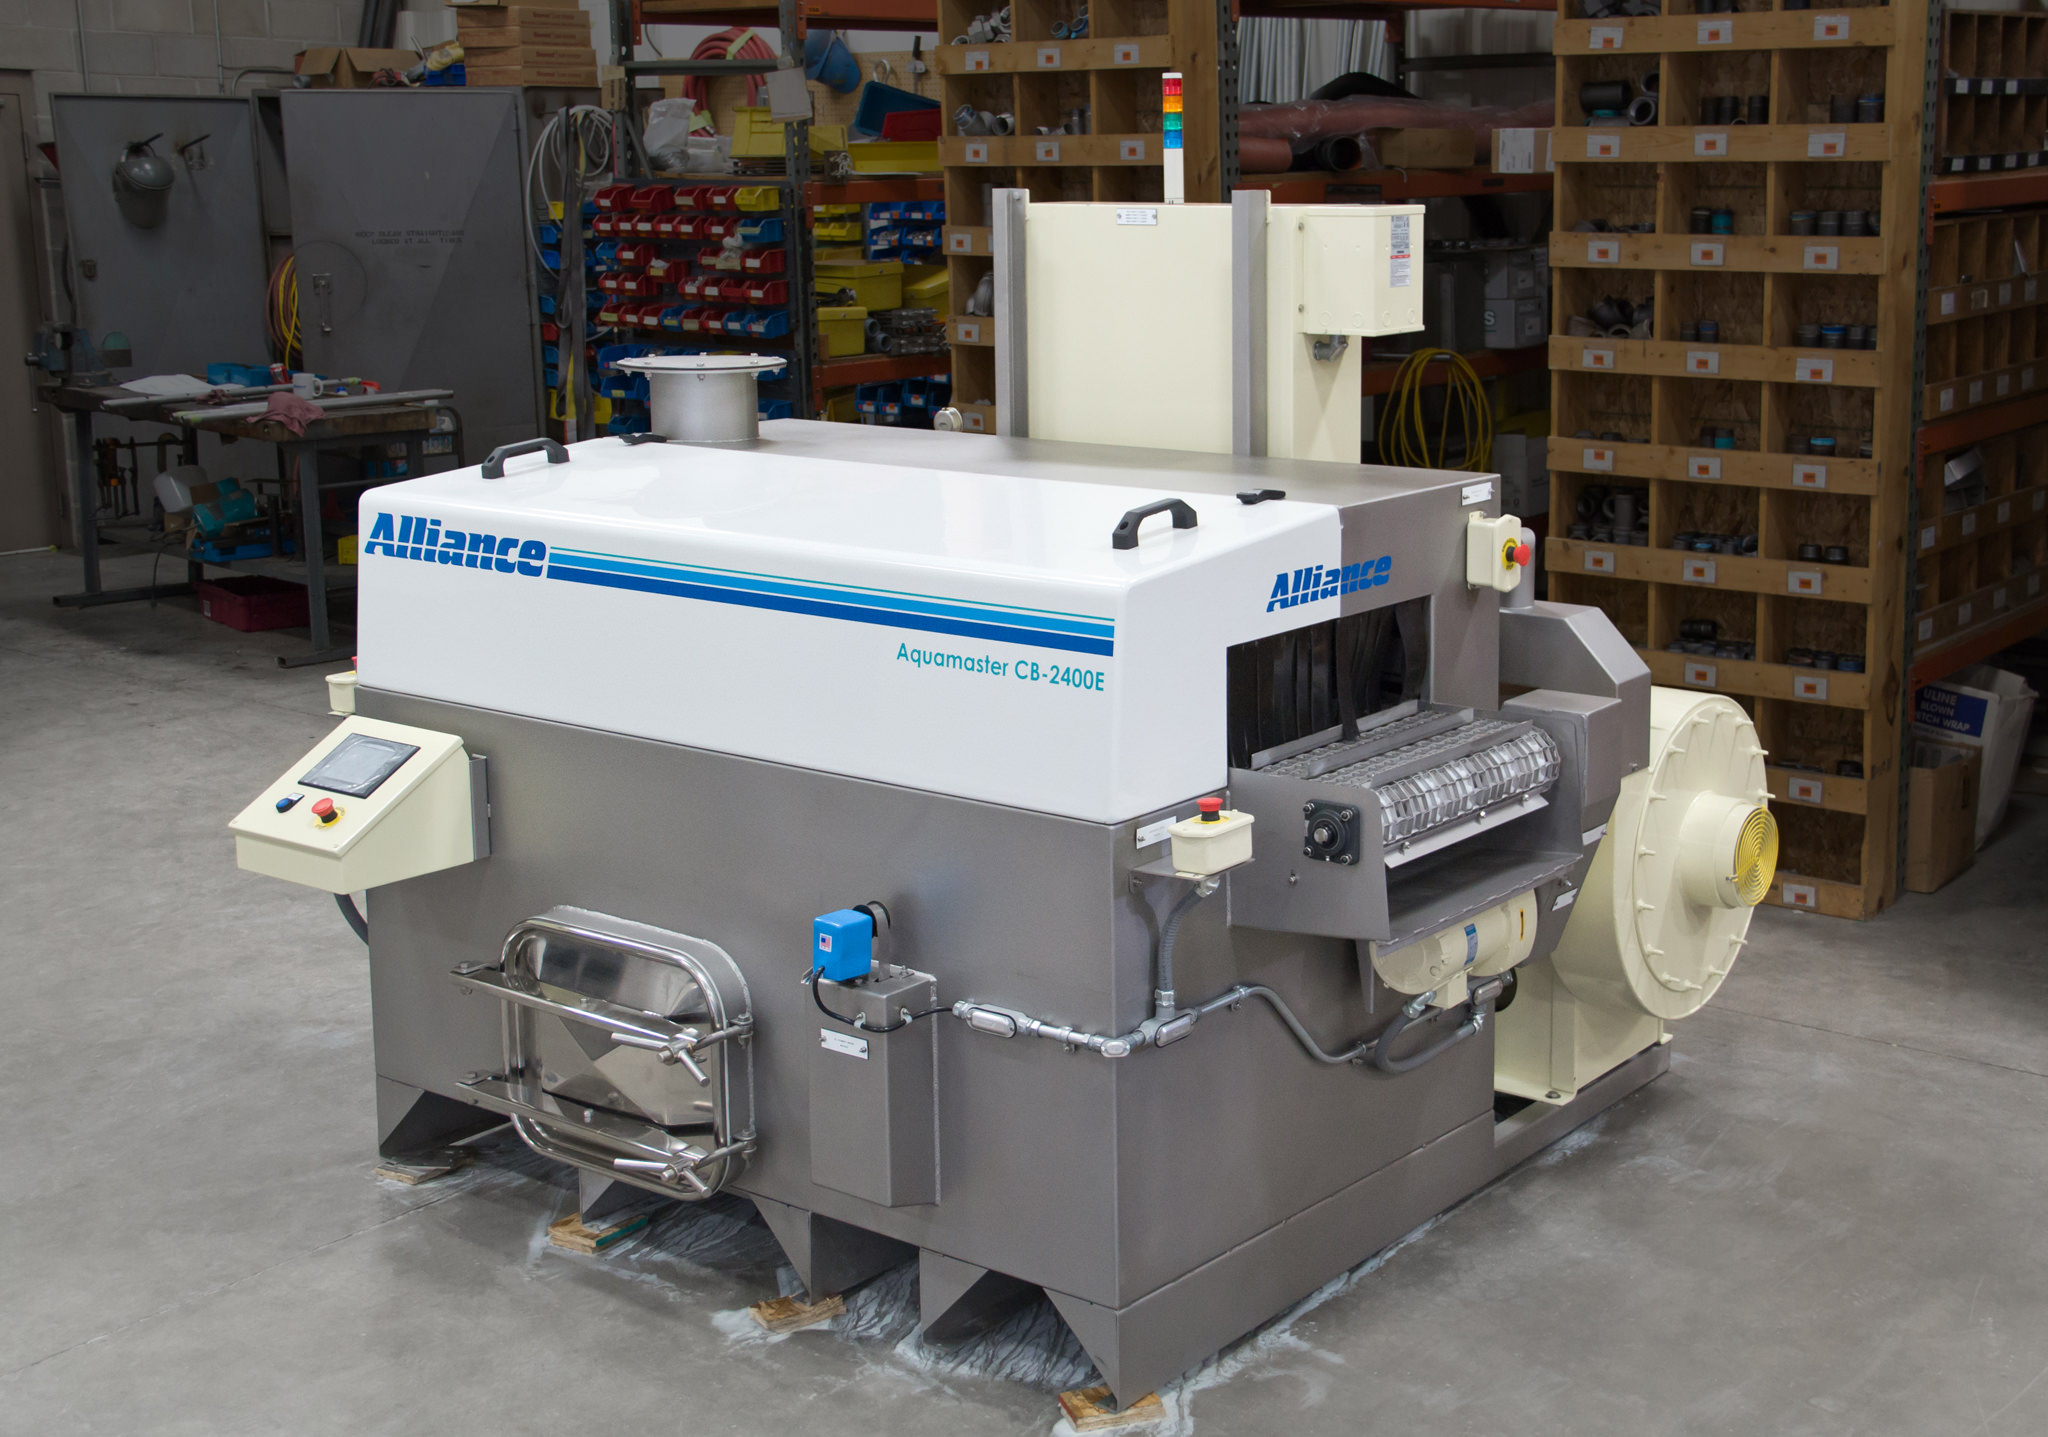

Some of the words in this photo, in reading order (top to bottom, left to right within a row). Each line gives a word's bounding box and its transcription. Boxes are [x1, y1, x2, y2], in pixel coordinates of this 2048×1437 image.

[364, 512, 547, 578] Alliance
[1266, 555, 1392, 613] Alliance
[896, 642, 1009, 677] Aquamaster
[1014, 660, 1105, 692] CB-2400E
[1920, 701, 1955, 717] BLOWN
[1923, 688, 1957, 705] ULINE
[1943, 719, 1970, 731] WRAP
